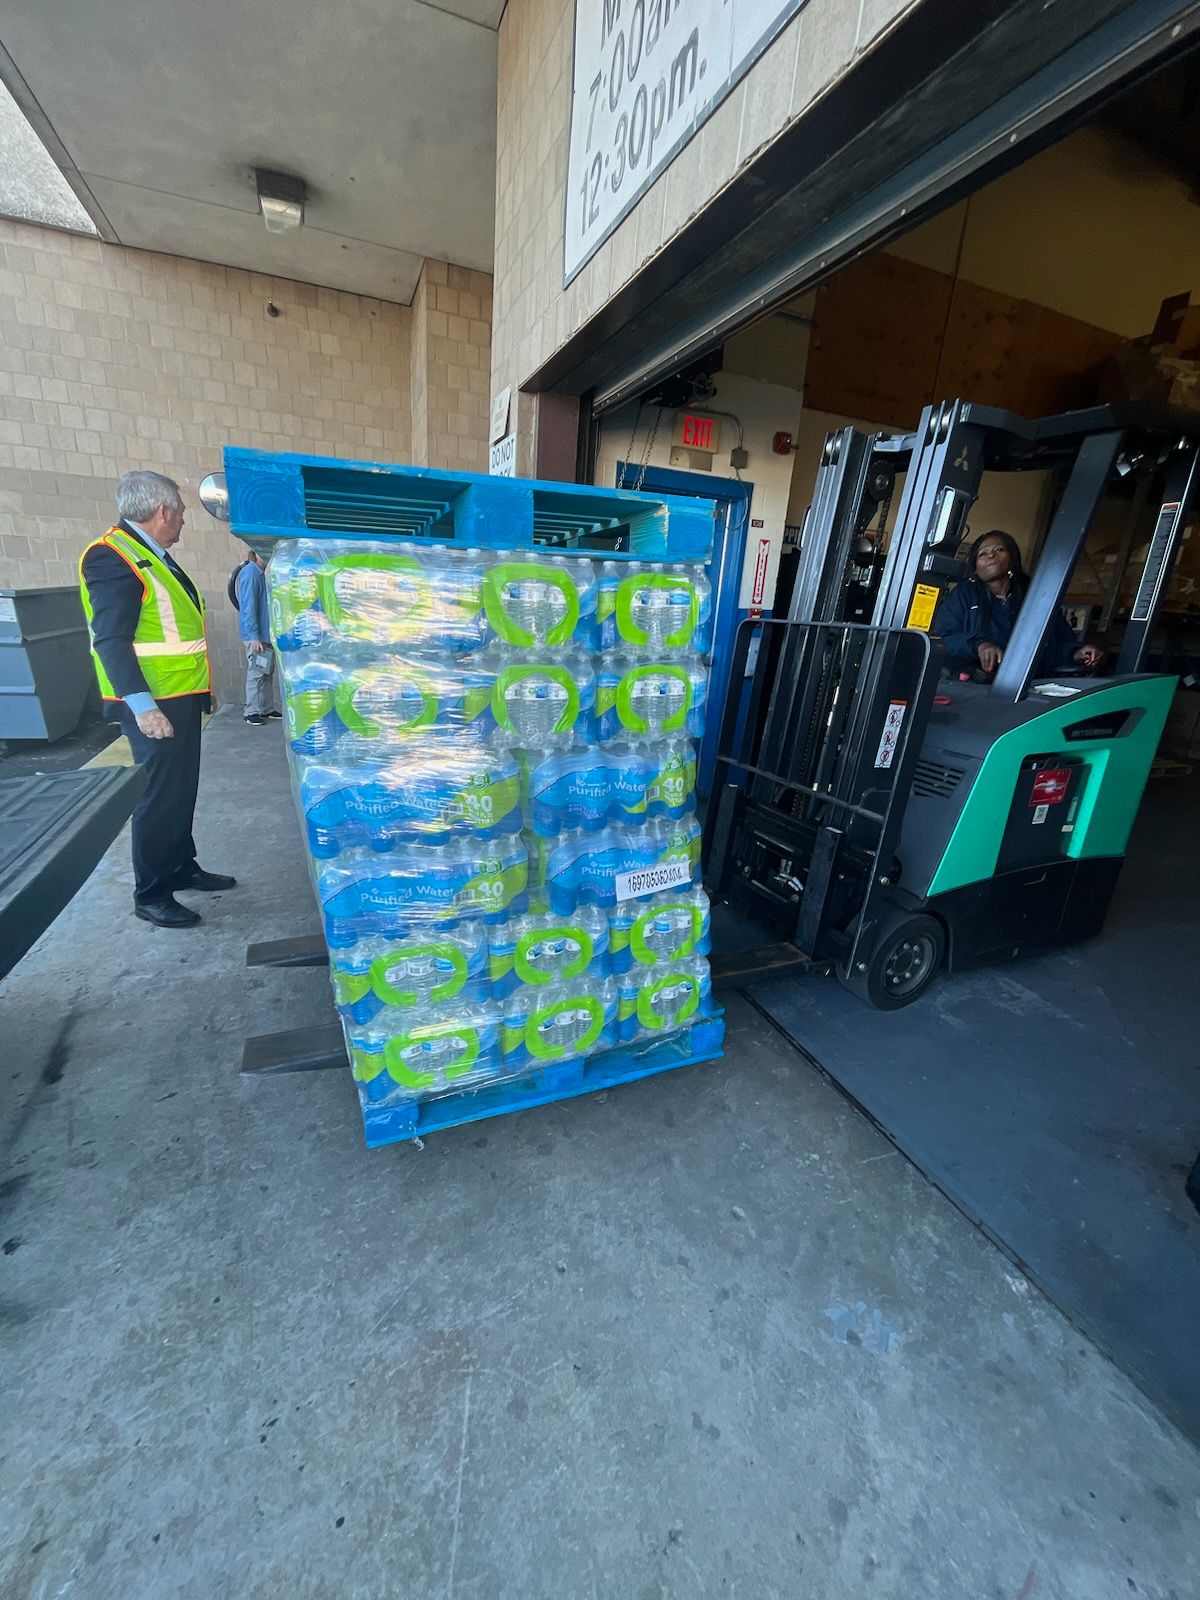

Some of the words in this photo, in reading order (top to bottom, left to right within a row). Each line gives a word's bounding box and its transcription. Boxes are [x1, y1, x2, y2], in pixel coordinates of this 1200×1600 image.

[586, 0, 680, 154] 7:00a
[579, 27, 707, 236] 12:30pm.
[684, 416, 713, 449] EXIT
[492, 447, 500, 469] DO
[501, 438, 515, 464] NOT
[568, 783, 612, 798] Purified
[614, 781, 646, 793] Water
[663, 777, 684, 793] 40
[345, 799, 399, 815] Purified
[401, 796, 446, 810] Water
[466, 794, 493, 813] 40
[361, 887, 413, 905] Purified
[416, 885, 454, 898] Water
[478, 881, 505, 897] 40
